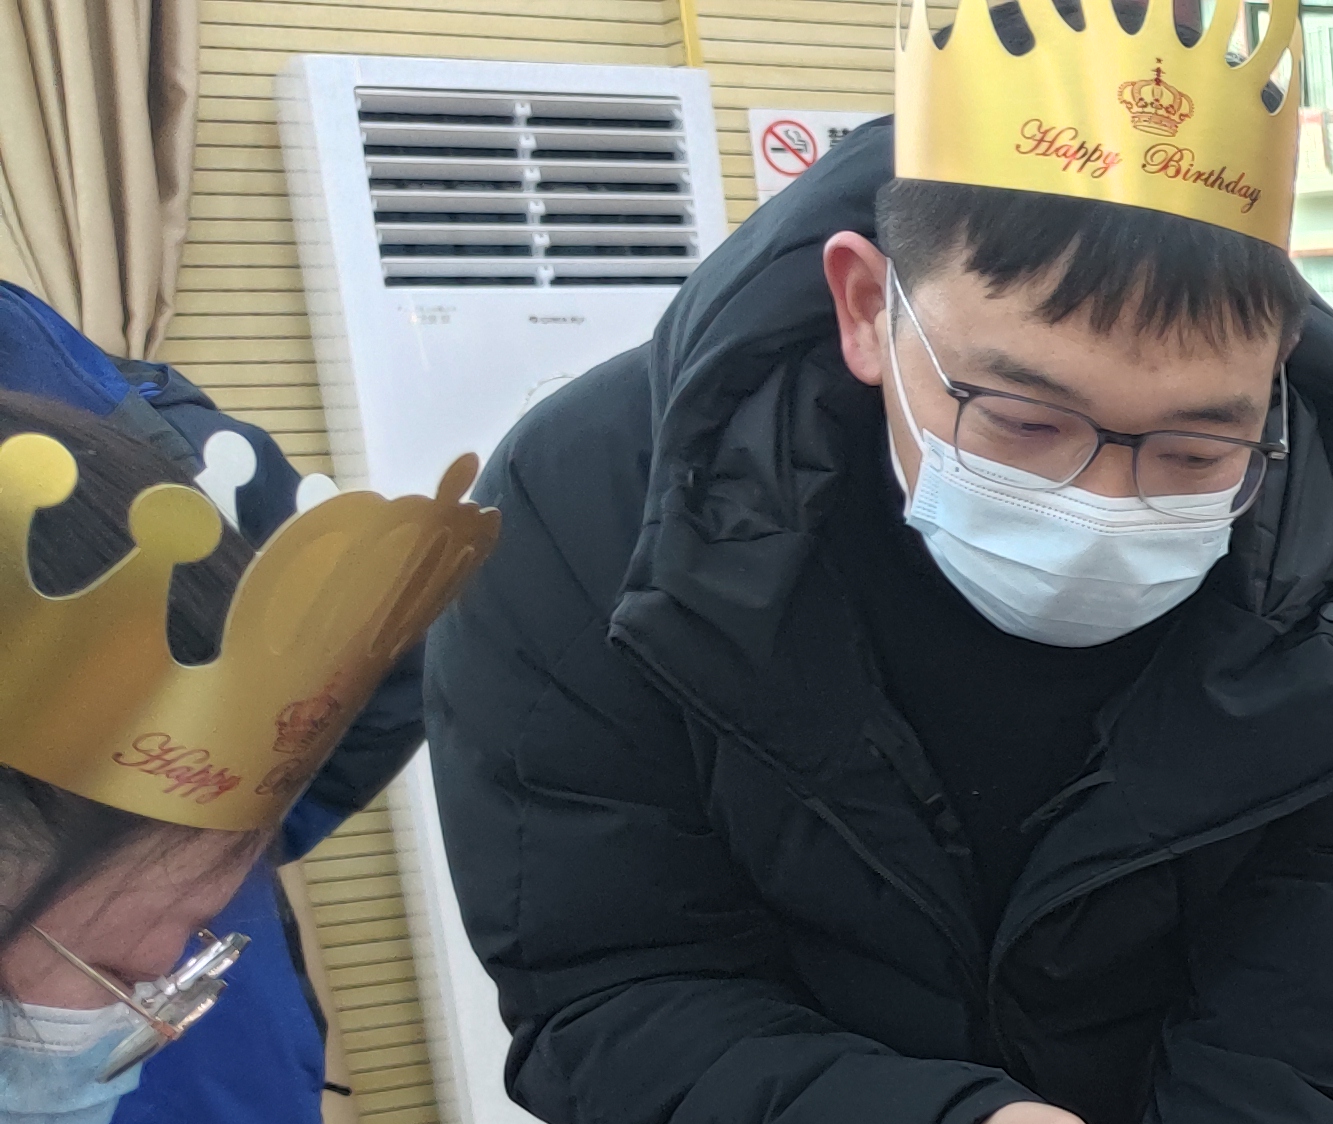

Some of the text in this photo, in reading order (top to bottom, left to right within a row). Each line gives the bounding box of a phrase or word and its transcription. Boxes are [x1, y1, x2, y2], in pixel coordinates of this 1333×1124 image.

[1016, 119, 1262, 214] Happy Birthday
[112, 732, 242, 804] Happy
